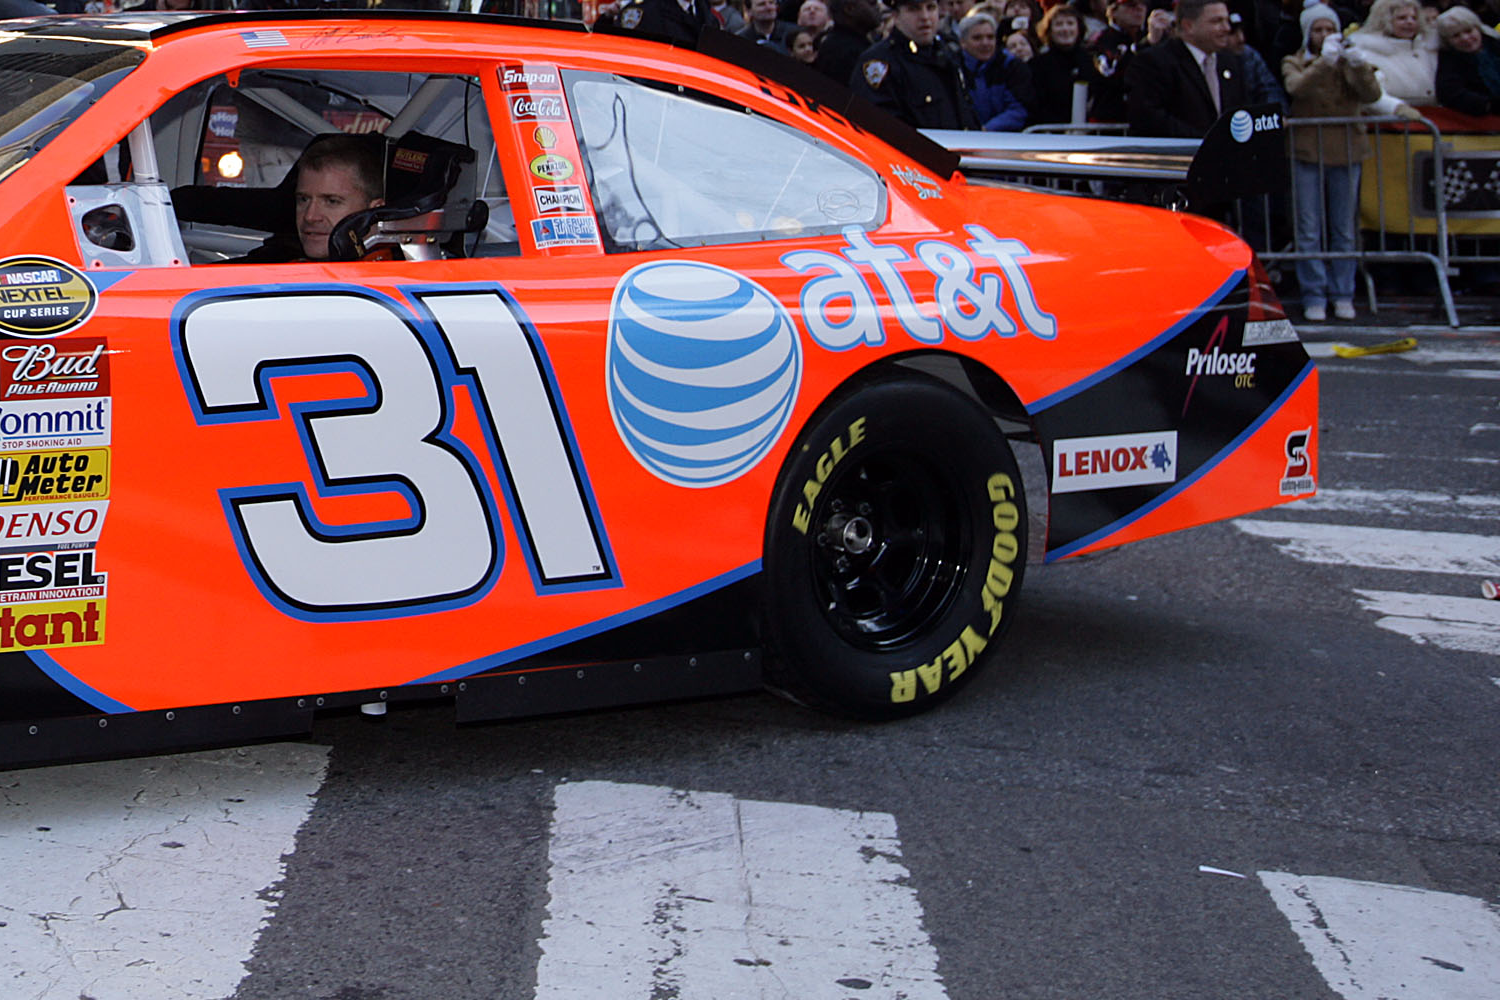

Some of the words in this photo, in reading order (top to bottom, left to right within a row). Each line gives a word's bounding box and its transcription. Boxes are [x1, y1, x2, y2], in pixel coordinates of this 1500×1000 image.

[503, 69, 555, 85] Snap-on
[1254, 111, 1280, 132] at&t
[539, 192, 581, 206] CHAMPION
[6, 269, 60, 285] NASCAR
[779, 224, 1058, 352] at&t
[3, 309, 27, 319] CUP
[30, 306, 70, 318] SERIES
[1, 343, 105, 382] Bud
[1185, 346, 1257, 376] Prilosec
[2, 441, 24, 449] STOP
[26, 438, 65, 449] SMOKING
[67, 438, 83, 446] AID
[178, 287, 618, 615] 31
[23, 452, 90, 476] Auto
[1057, 446, 1149, 479] LENOX
[16, 474, 103, 496] Meter
[792, 415, 867, 536] EAGLE
[24, 493, 72, 502] PERFORMANCE
[73, 491, 100, 499] GAUGES
[38, 587, 101, 601] INNOVATION
